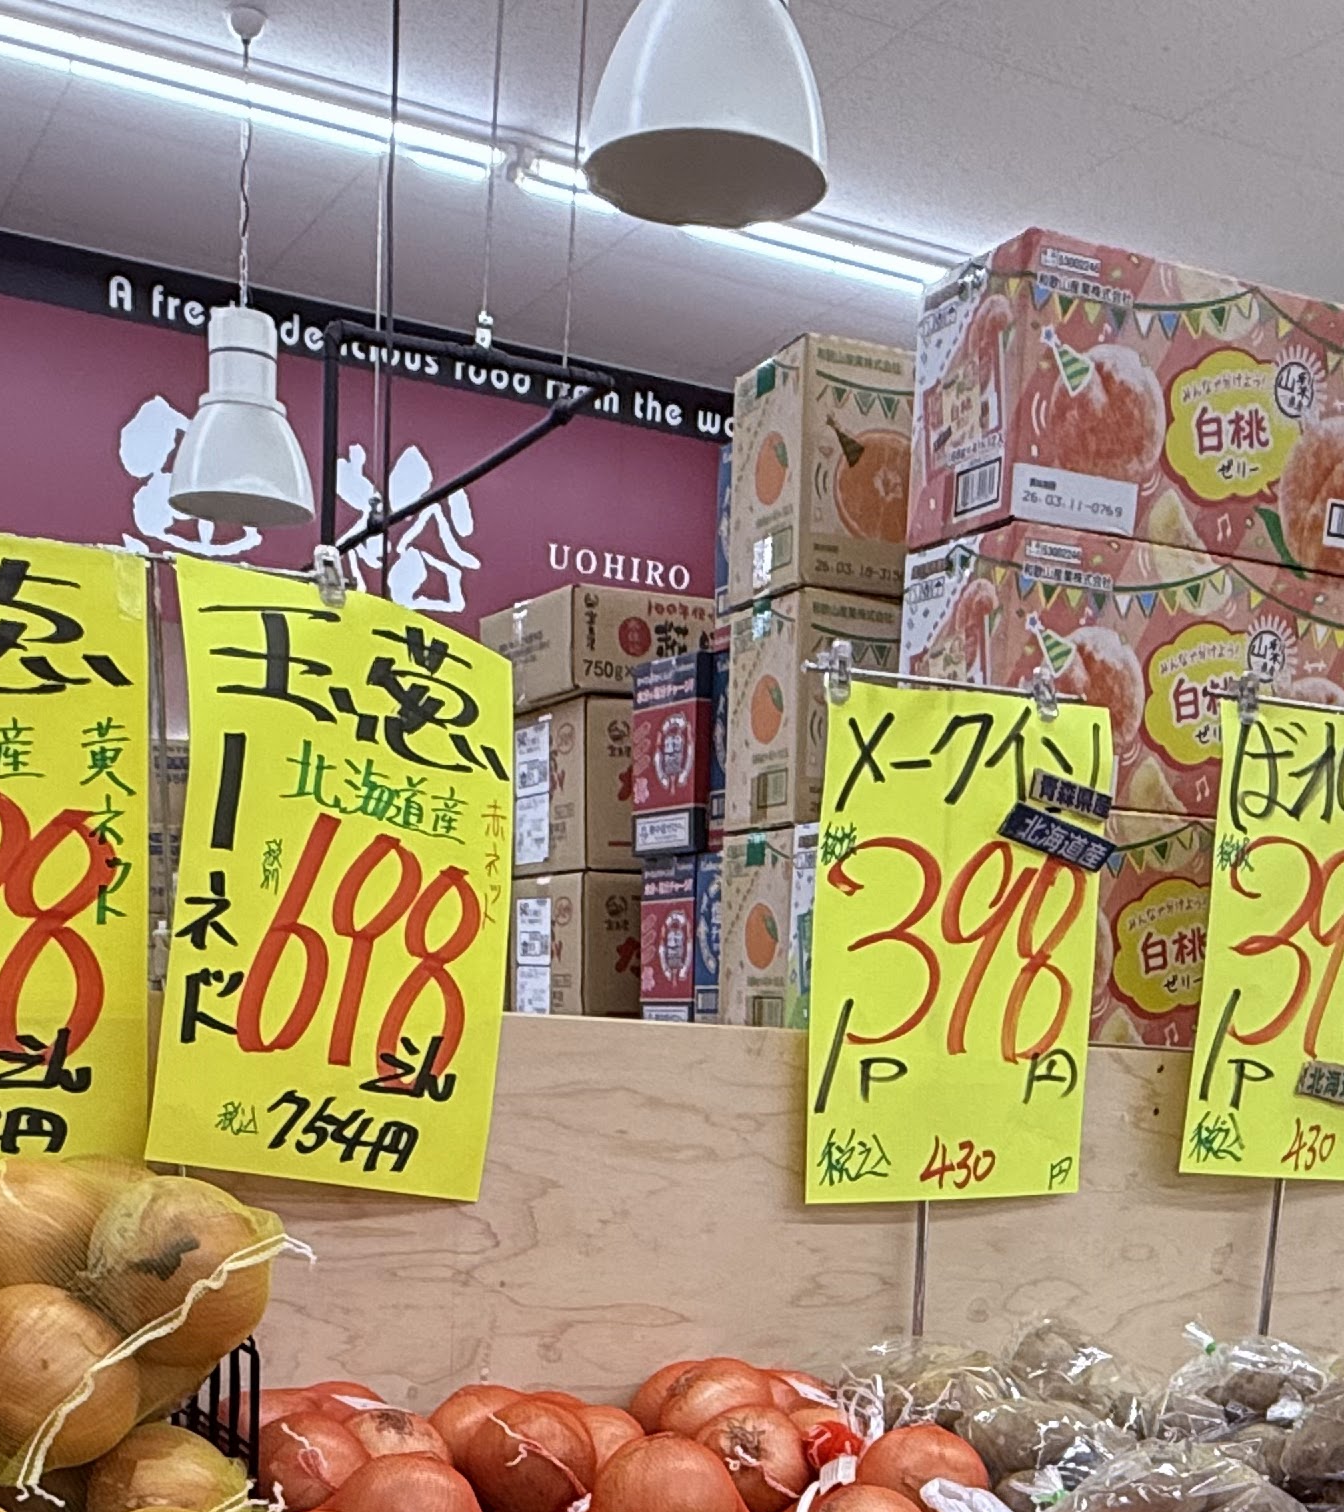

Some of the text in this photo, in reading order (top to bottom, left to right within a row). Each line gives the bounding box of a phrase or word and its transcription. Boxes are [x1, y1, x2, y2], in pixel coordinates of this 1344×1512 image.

[109, 275, 132, 311] A
[152, 284, 214, 327] fre
[634, 390, 683, 426] the
[1196, 406, 1269, 455] 白桃
[1217, 458, 1259, 480] ゼリー
[548, 543, 691, 590] UOHIRO
[279, 738, 467, 846] 北海道産
[834, 706, 1101, 812] メークイン
[79, 716, 138, 925] 黄ネット
[1017, 814, 1108, 870] 北海道産
[481, 799, 508, 930] 赤ネット
[237, 812, 481, 1090] 698
[827, 836, 1089, 1064] 398
[1141, 927, 1207, 975] 白桃
[1023, 1047, 1078, 1105] 円
[267, 1089, 420, 1172] 754円
[819, 1128, 1073, 1191] 税込 430 円
[1189, 1112, 1244, 1164] 税込
[1281, 1117, 1336, 1172] 430
